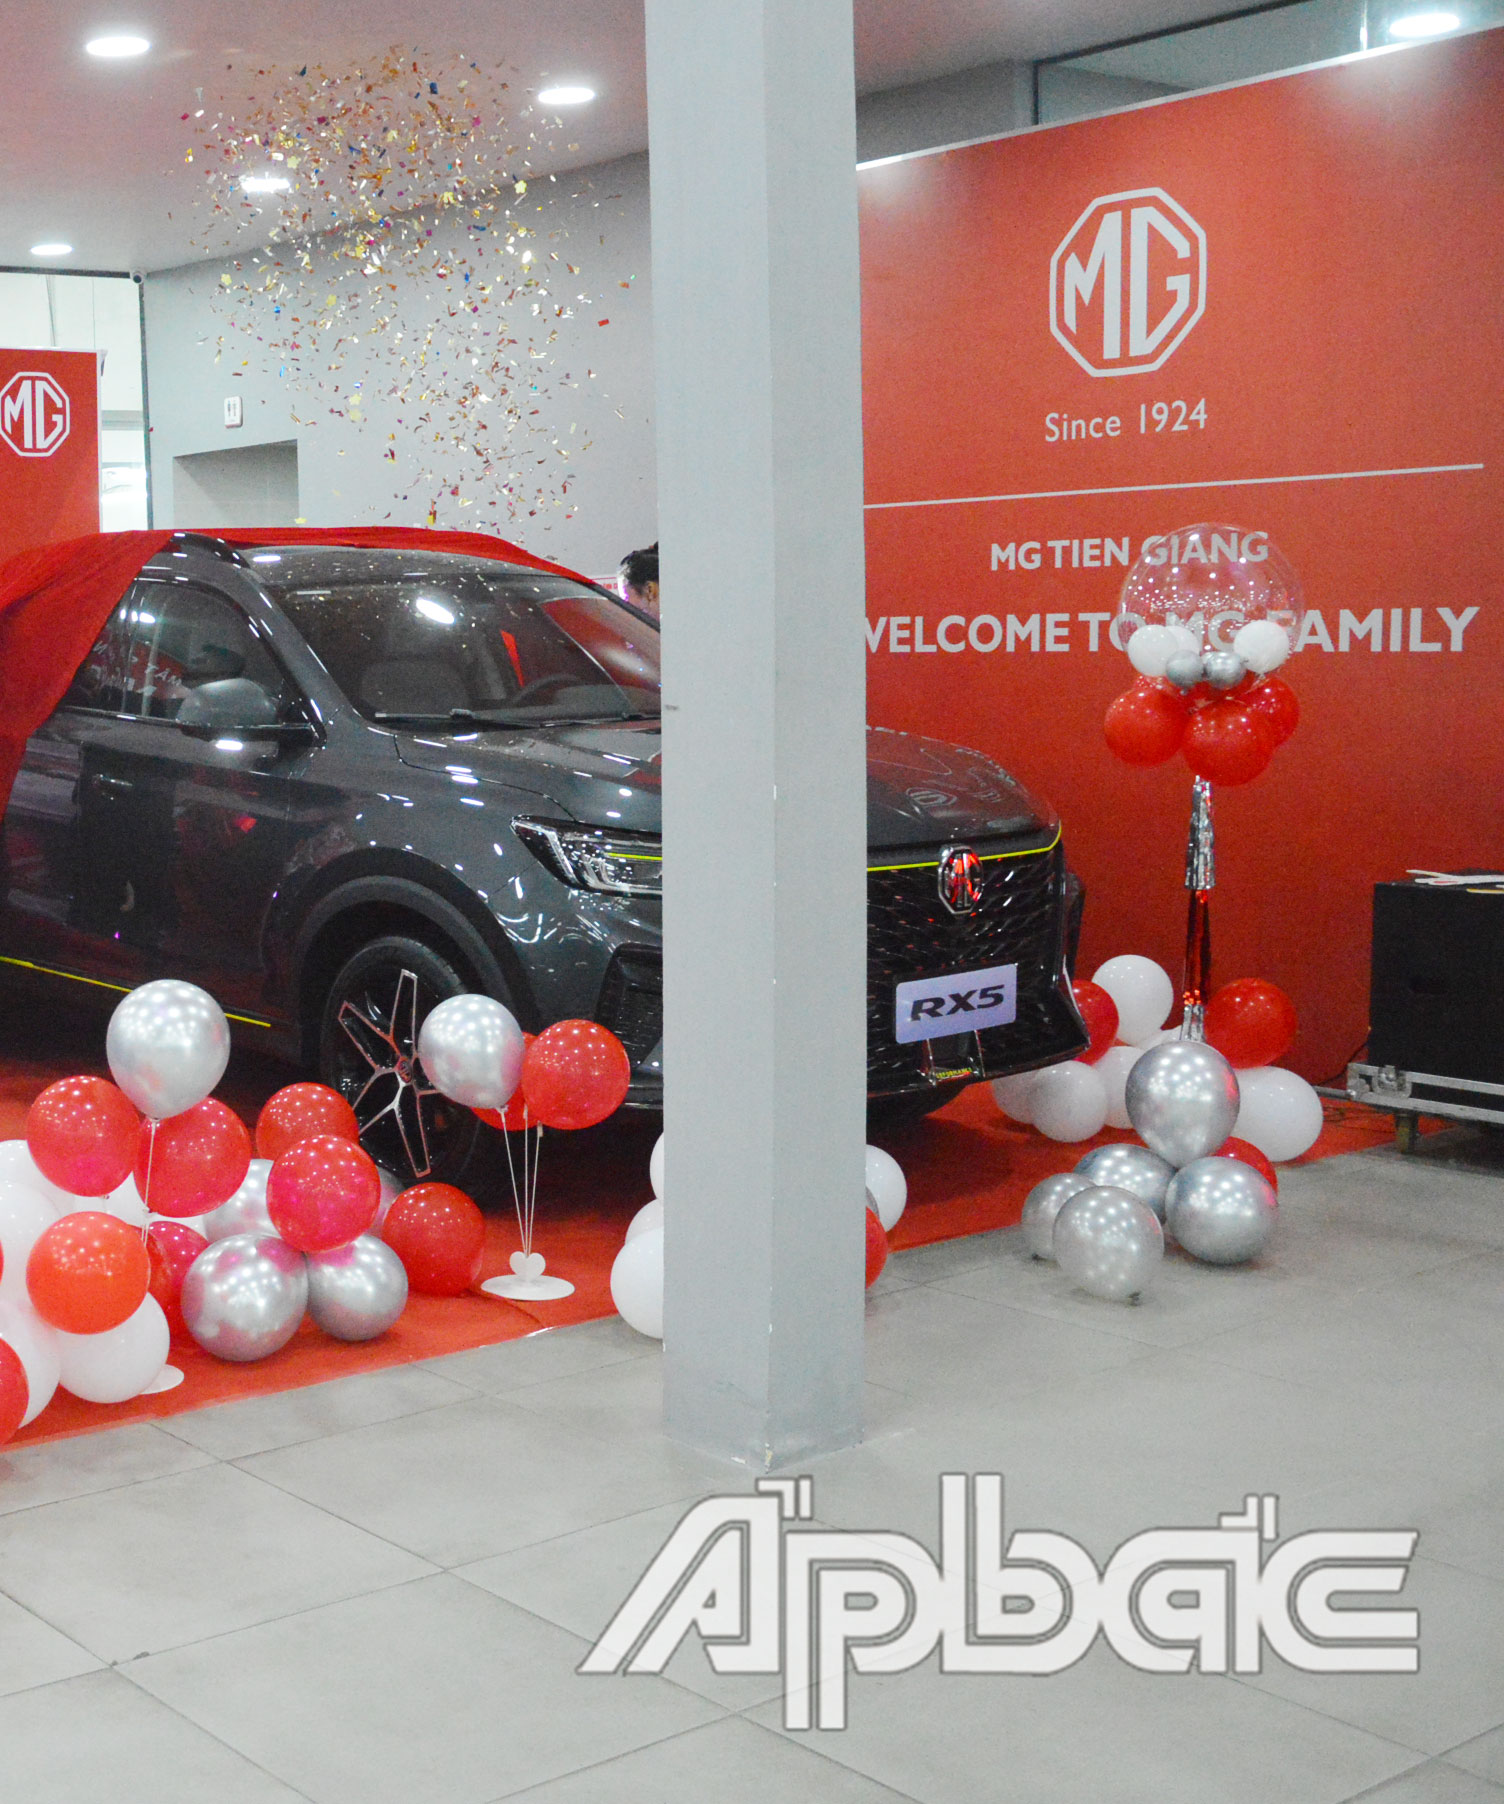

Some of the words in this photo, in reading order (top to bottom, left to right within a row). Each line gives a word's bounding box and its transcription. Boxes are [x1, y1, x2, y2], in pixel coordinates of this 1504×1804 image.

[1062, 204, 1192, 361] MG
[3, 378, 64, 450] MG
[1045, 409, 1122, 442] Since
[1139, 397, 1209, 434] 1924
[991, 541, 1042, 571] MG
[1047, 536, 1130, 568] TIEN
[1140, 530, 1270, 568] GIANG
[909, 983, 1006, 1023] RX5
